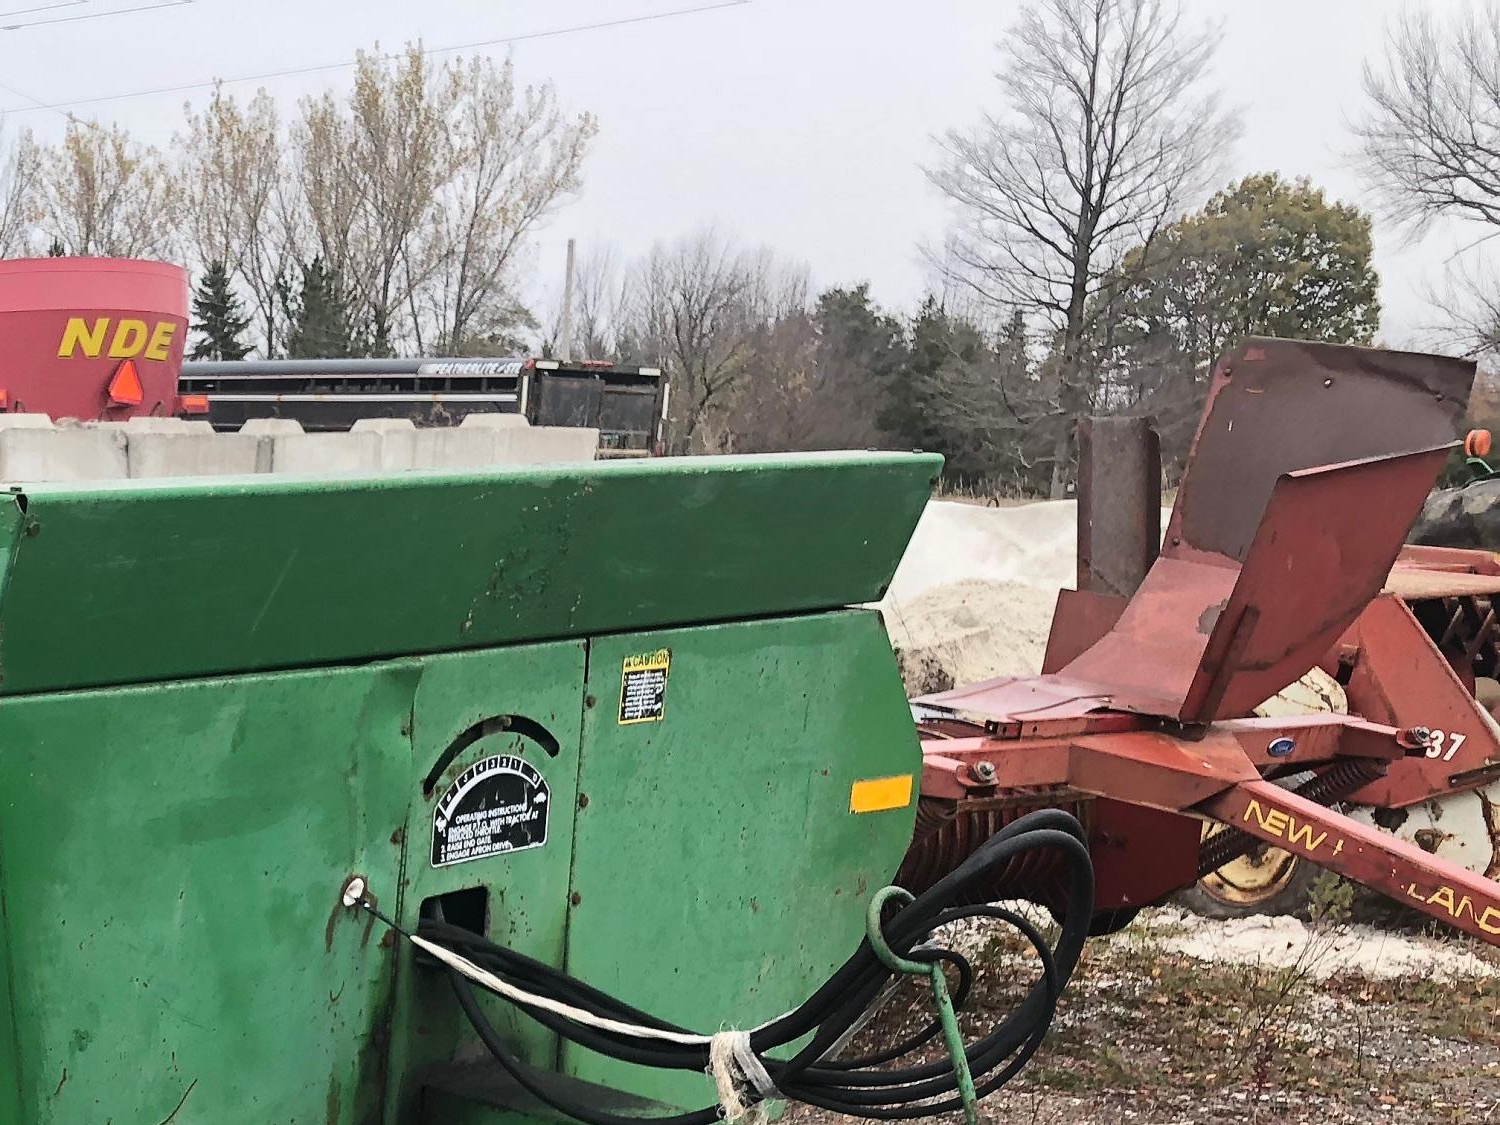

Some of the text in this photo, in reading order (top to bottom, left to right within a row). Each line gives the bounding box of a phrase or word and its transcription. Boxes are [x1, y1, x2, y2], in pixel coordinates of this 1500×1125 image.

[58, 317, 177, 361] NDE
[633, 652, 669, 667] CAUTION
[1426, 729, 1467, 761] 37
[463, 774, 468, 783] 5
[478, 763, 484, 771] 4
[490, 759, 496, 768] 3
[502, 758, 507, 767] 2
[513, 760, 518, 768] 1
[455, 810, 487, 824] OPERATING
[489, 817, 505, 828] WITH
[505, 811, 531, 825] TRACTOR
[531, 810, 539, 820] AT
[1243, 800, 1328, 851] NEW
[446, 840, 463, 852] RAISE
[463, 838, 476, 849] END
[446, 848, 470, 861] ENGAGE
[471, 844, 492, 857] APRON
